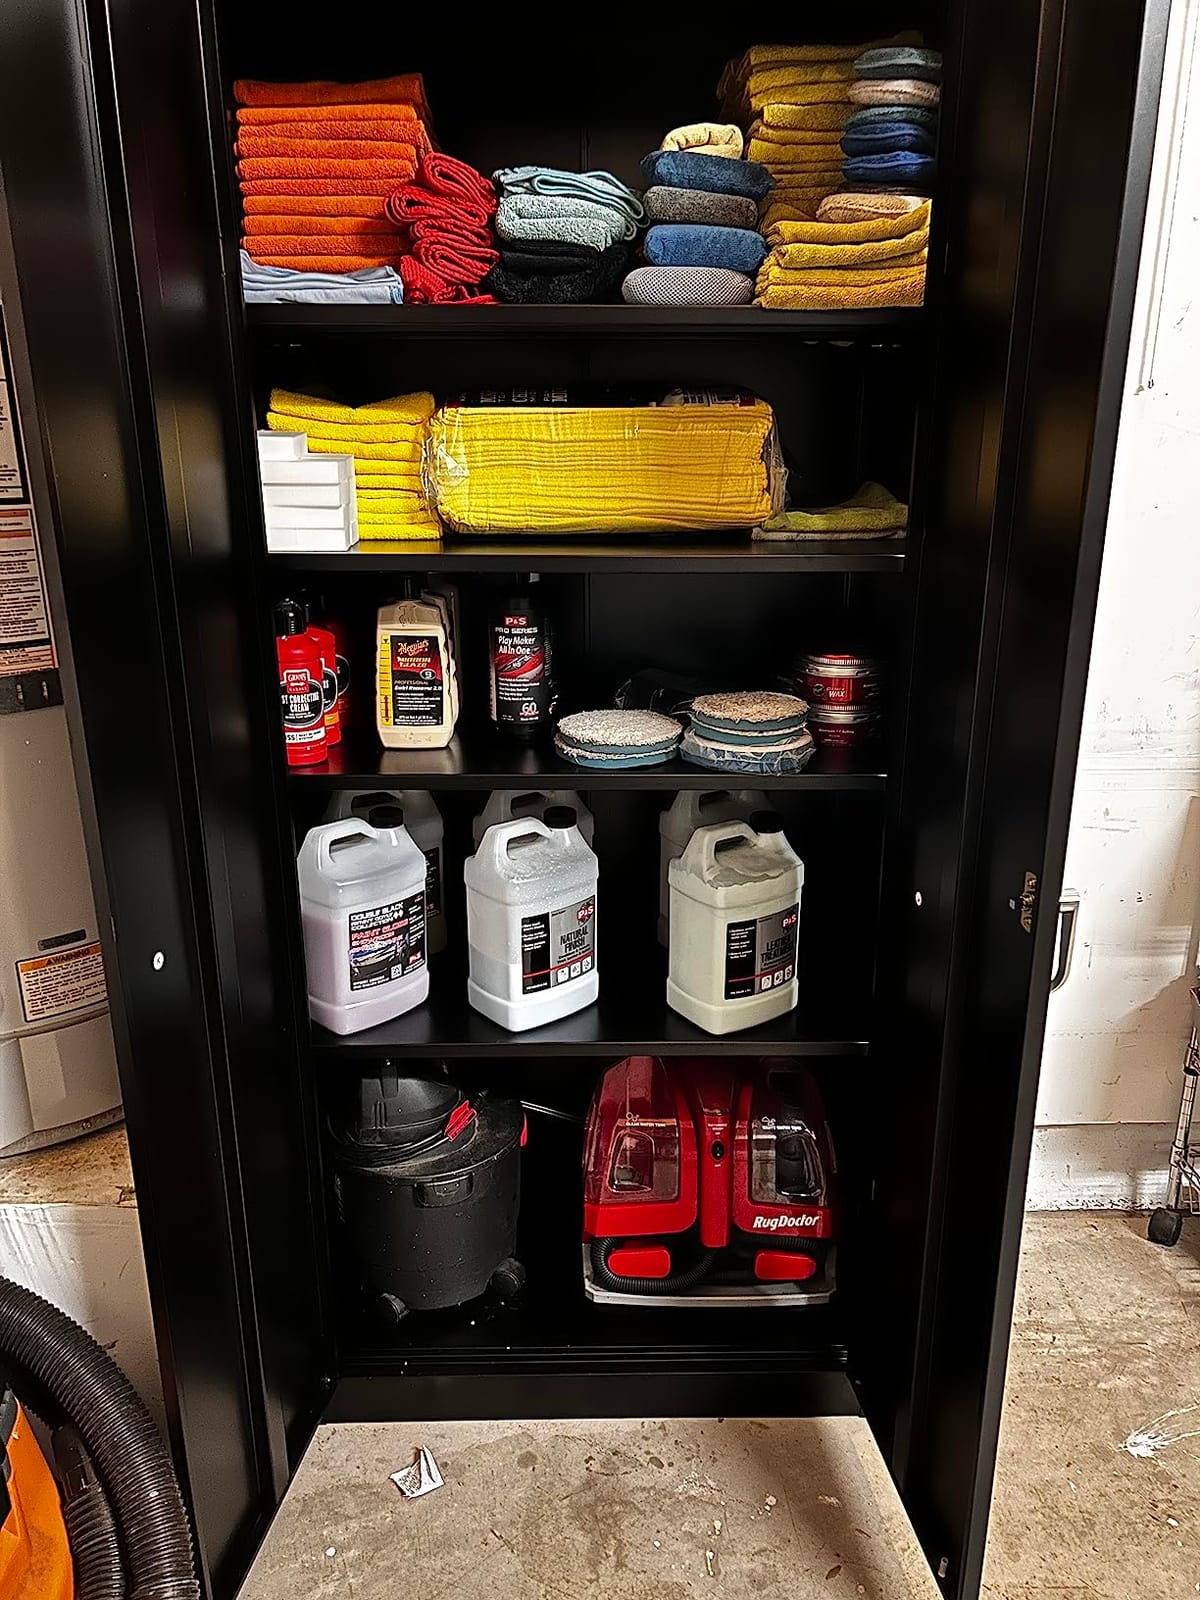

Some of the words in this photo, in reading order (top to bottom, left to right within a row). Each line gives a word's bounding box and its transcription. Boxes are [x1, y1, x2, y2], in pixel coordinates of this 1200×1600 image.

[498, 635, 513, 647] Play
[513, 635, 536, 645] Maker
[499, 645, 508, 654] All
[508, 645, 515, 655] In
[516, 645, 531, 655] One
[425, 671, 432, 679] 9
[828, 690, 846, 698] WAX
[289, 702, 310, 713] CREAM
[521, 702, 537, 714] 60
[560, 925, 589, 946] NATURAL
[51, 947, 91, 964] WARNING
[752, 1214, 820, 1231] RugDoctor
